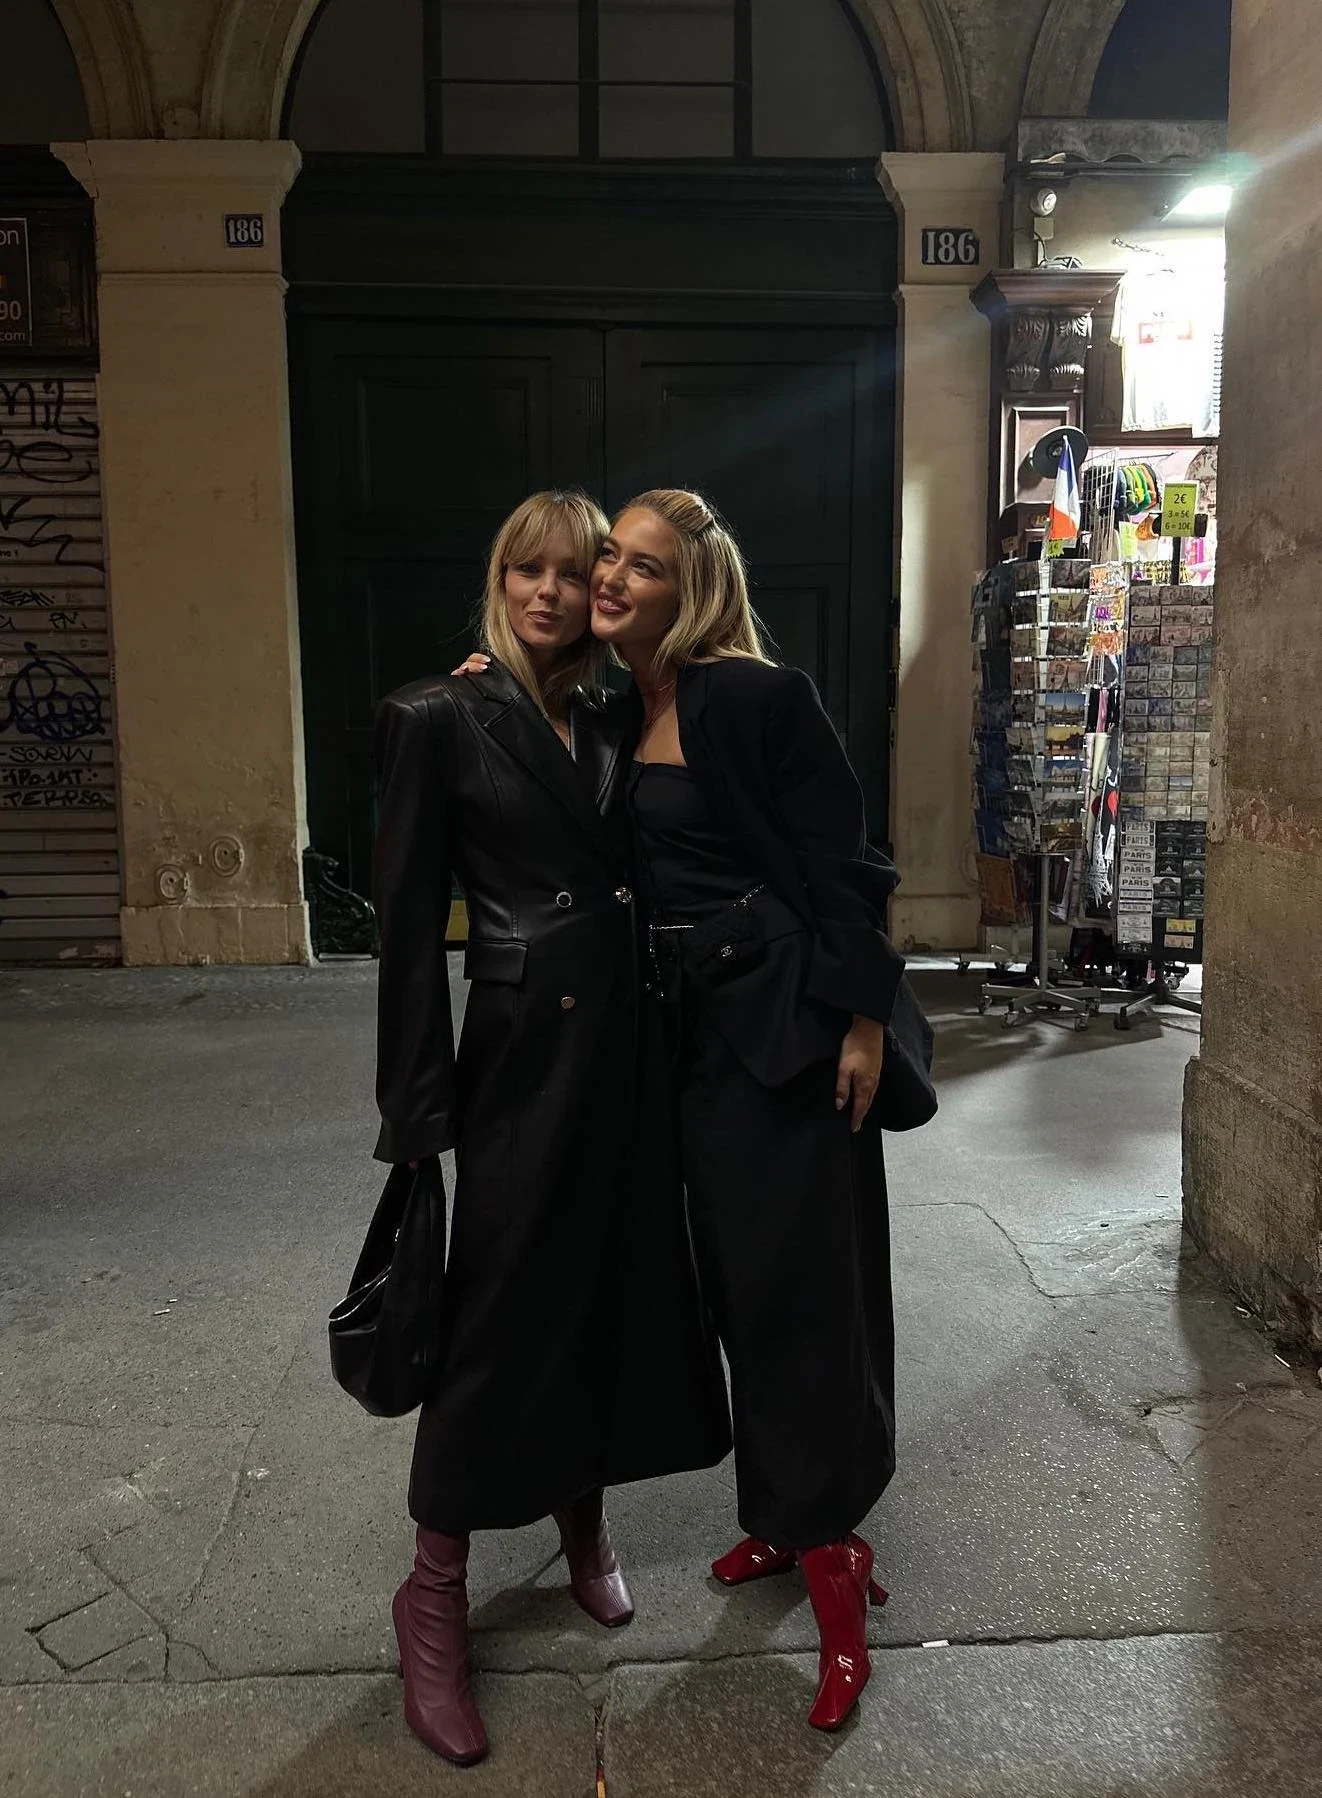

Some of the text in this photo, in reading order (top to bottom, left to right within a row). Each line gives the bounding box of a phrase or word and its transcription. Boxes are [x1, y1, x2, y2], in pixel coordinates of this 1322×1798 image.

[228, 218, 262, 243] 186
[925, 231, 976, 264] 186
[1174, 493, 1187, 504] 2€
[1127, 836, 1148, 845] PARIS
[1124, 851, 1152, 860] PARIS
[1124, 865, 1151, 874] PARIS
[1122, 879, 1149, 887] PARIS
